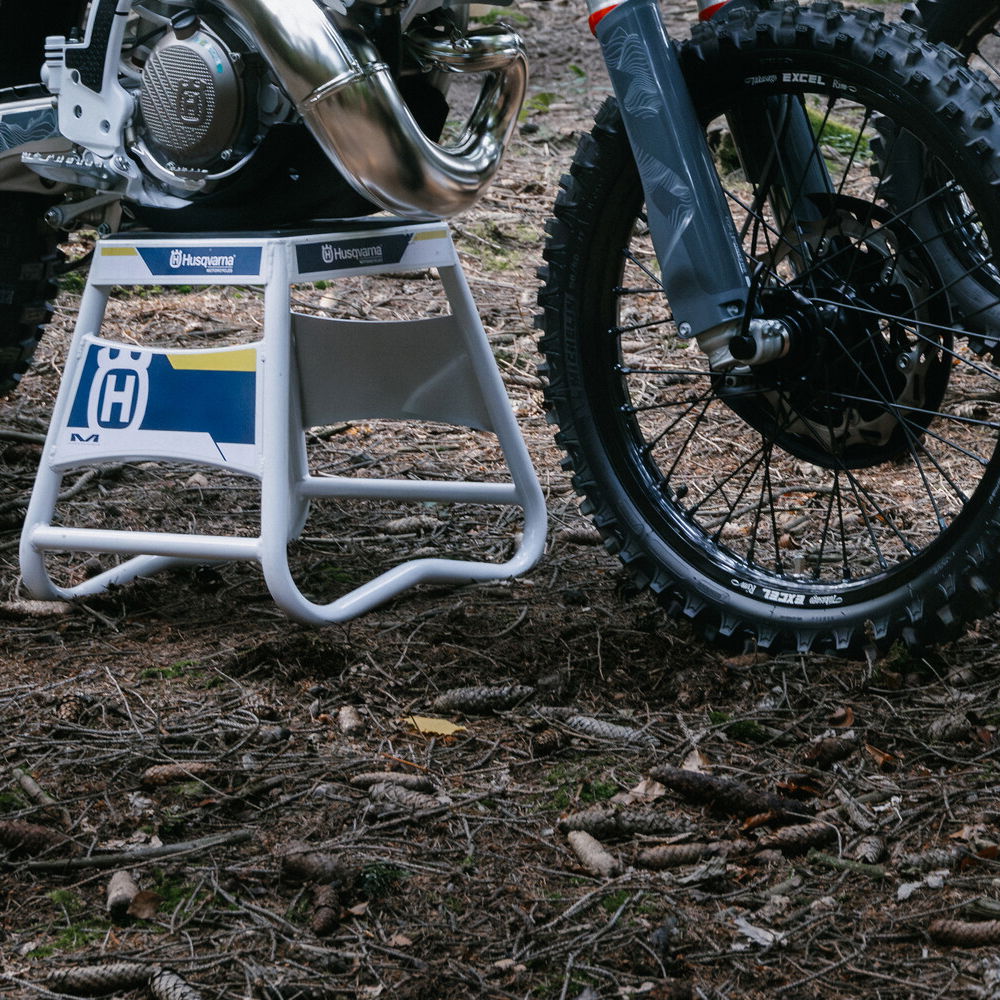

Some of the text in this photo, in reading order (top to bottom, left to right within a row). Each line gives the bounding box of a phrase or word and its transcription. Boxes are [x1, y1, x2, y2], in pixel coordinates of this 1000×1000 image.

[782, 72, 826, 86] EXCEL
[181, 253, 234, 269] Husqvarna
[334, 245, 383, 263] Husqvarna
[761, 588, 806, 606] EXCEL
